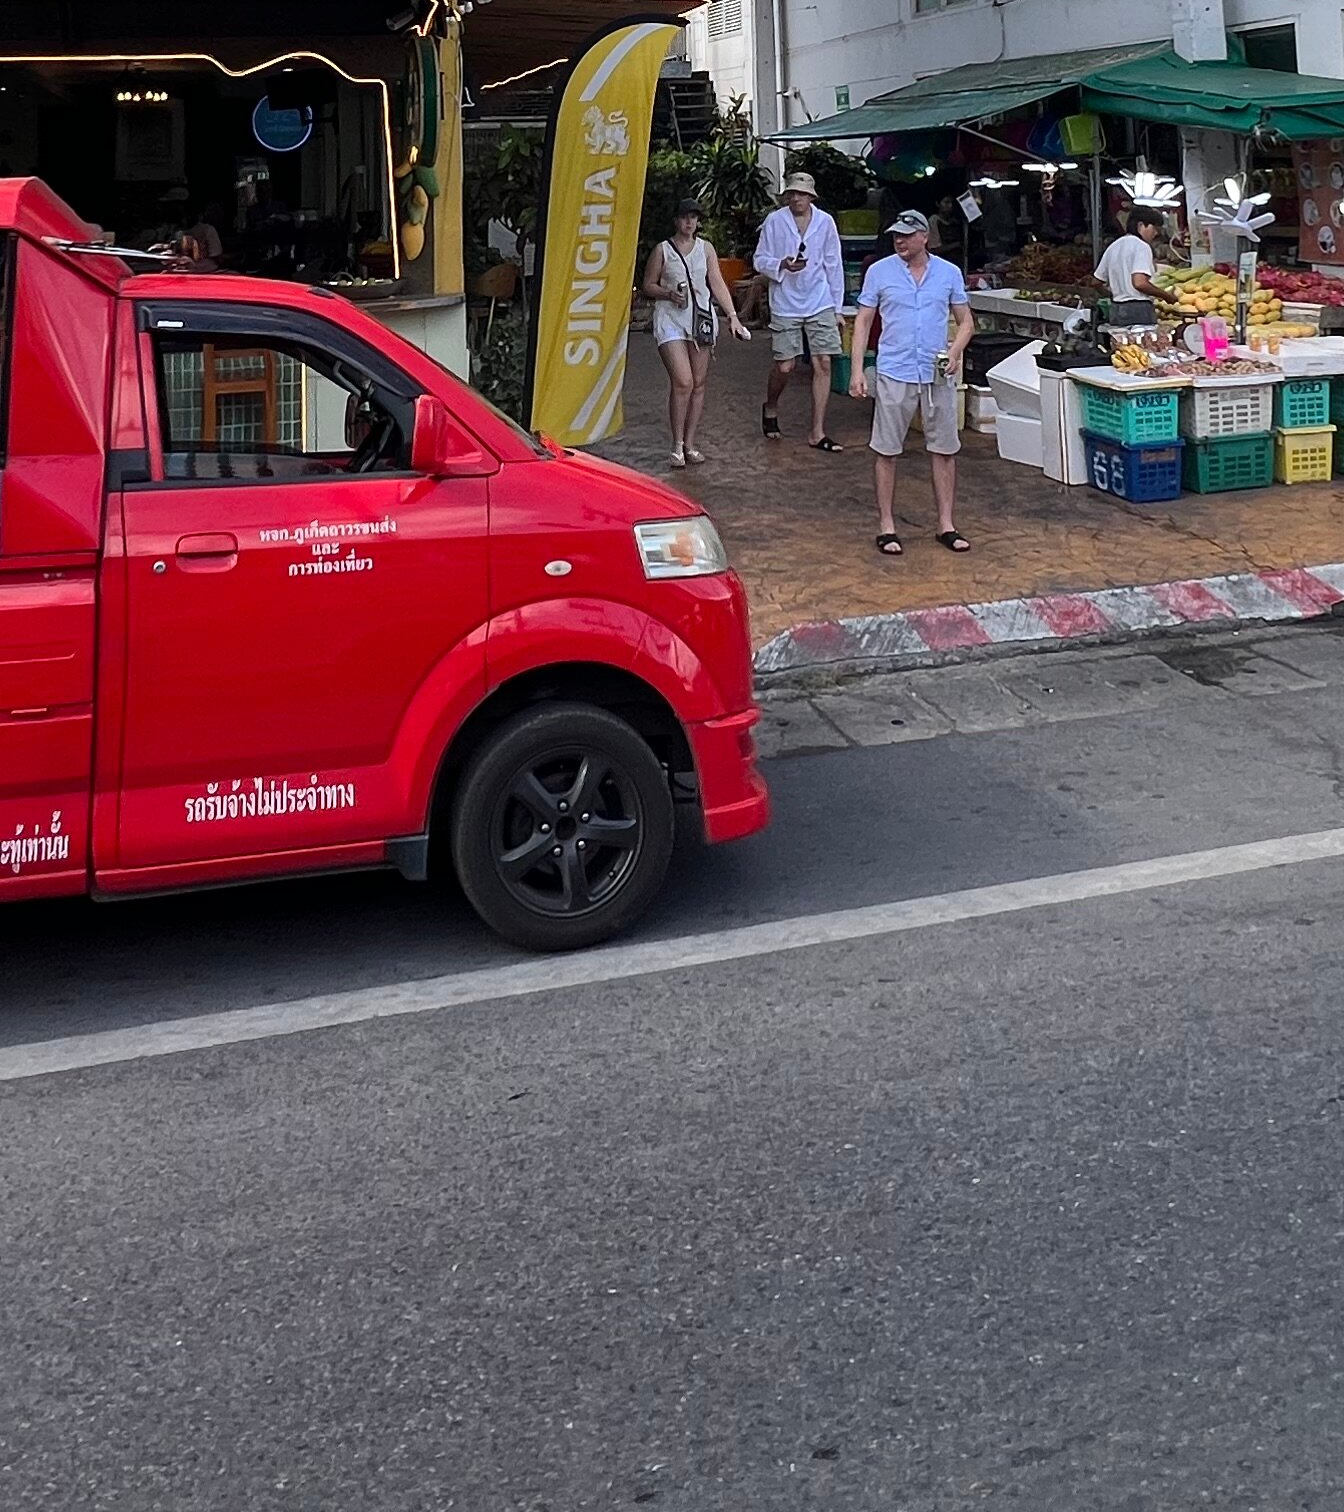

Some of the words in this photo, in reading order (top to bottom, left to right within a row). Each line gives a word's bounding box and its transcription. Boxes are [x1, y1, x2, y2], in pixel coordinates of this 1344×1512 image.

[564, 166, 619, 368] SINGHA
[288, 549, 374, 577] การท่องเที่ยว
[311, 542, 340, 556] และ
[184, 774, 355, 823] รถรับจ้างไม่ประจำทาง
